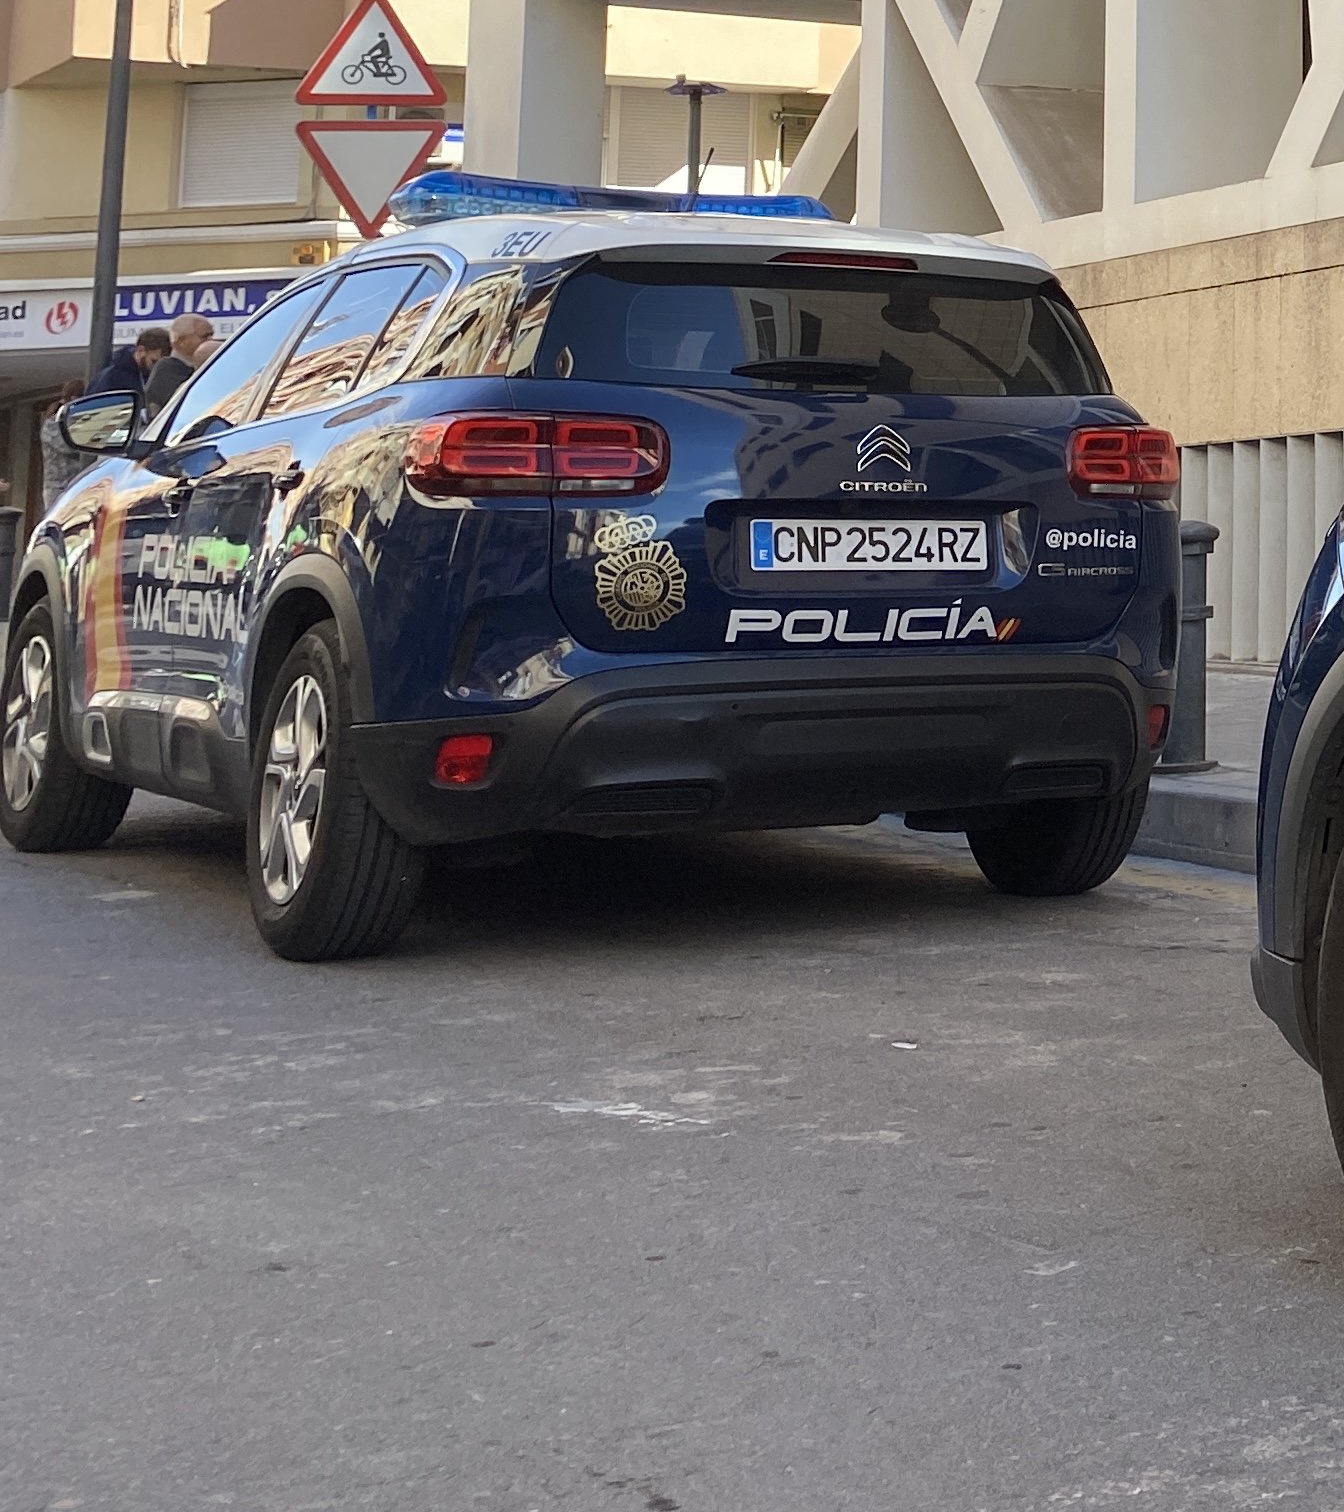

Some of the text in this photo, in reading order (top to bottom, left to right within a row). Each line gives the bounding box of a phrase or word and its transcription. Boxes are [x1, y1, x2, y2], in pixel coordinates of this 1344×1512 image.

[1045, 528, 1137, 551] @policia
[132, 584, 249, 644] NACIONAL
[724, 597, 998, 643] POLICÍA
